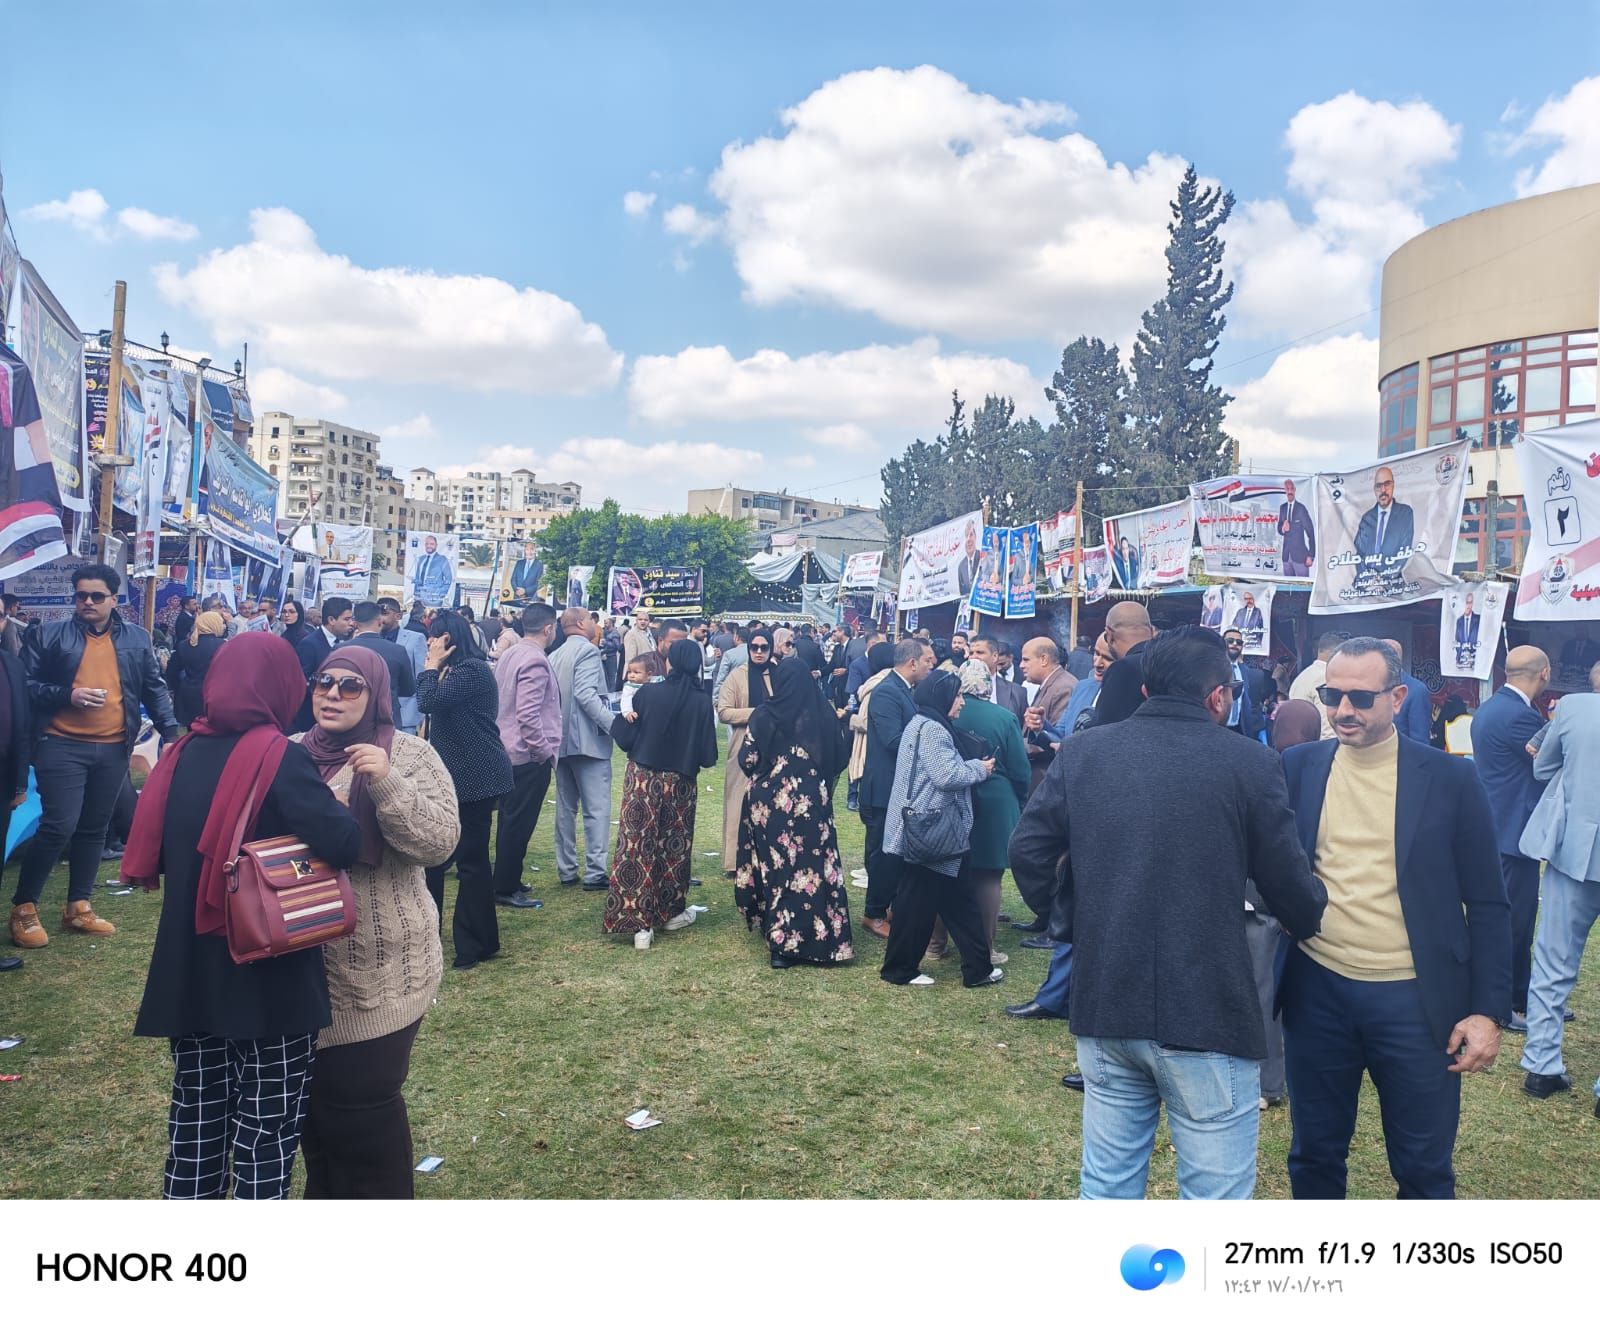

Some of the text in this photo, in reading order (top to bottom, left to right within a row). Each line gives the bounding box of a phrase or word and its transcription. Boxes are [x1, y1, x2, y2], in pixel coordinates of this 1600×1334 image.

[1329, 476, 1344, 486] رقم
[1548, 467, 1571, 496] رقم
[1556, 505, 1570, 538] ٢
[1263, 557, 1279, 571] رقم
[1328, 551, 1361, 568] صلاح
